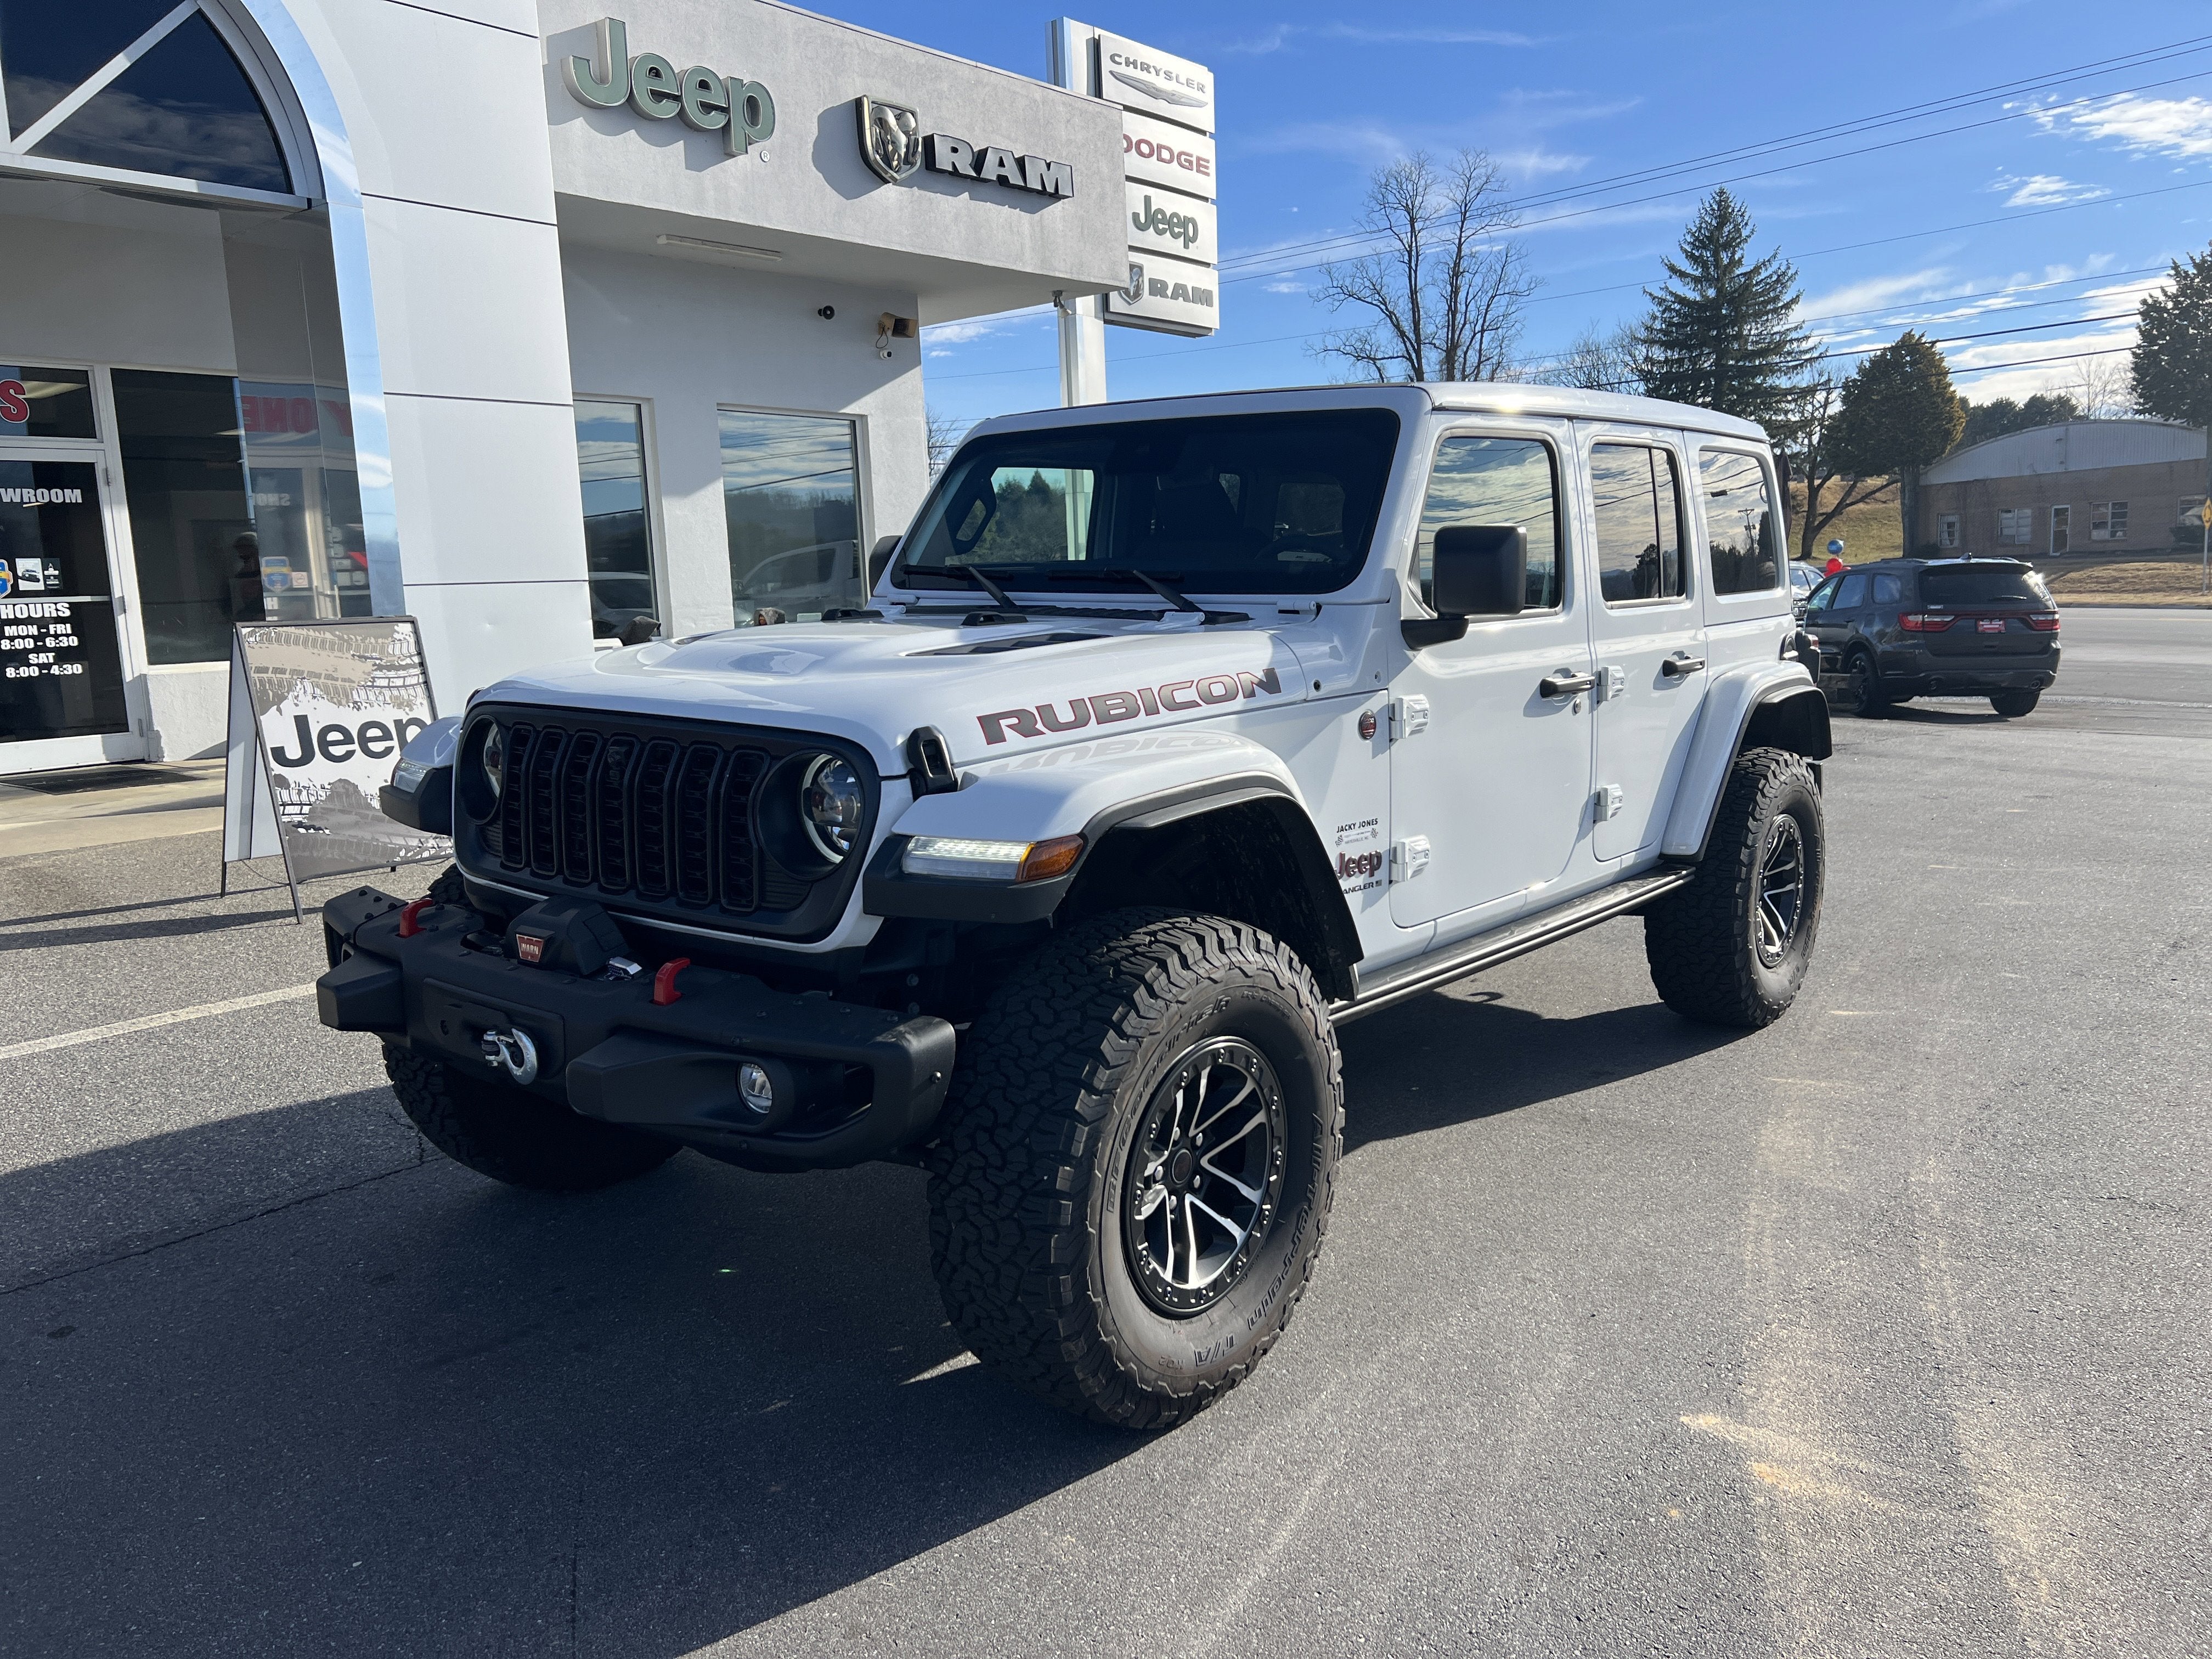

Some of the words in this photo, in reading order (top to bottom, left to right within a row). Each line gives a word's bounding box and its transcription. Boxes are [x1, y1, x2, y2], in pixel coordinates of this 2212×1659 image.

[562, 16, 775, 156] Jeep
[1109, 53, 1206, 94] CHRYSLER
[926, 132, 1074, 198] RAM
[1132, 195, 1199, 249] Jeep
[1149, 277, 1213, 307] RAM
[0, 602, 71, 619] HOURS
[1, 637, 35, 650] 8:00
[45, 636, 78, 647] 6:30
[4, 624, 38, 636] MON
[48, 623, 72, 634] FRI
[5, 666, 39, 678] 8:00
[50, 663, 83, 675] 4:30
[28, 653, 55, 664] SAT
[977, 668, 1282, 745] RUBICON
[1336, 822, 1356, 833] JACKY
[1358, 817, 1378, 828] JONES
[1334, 849, 1382, 880] Jeep
